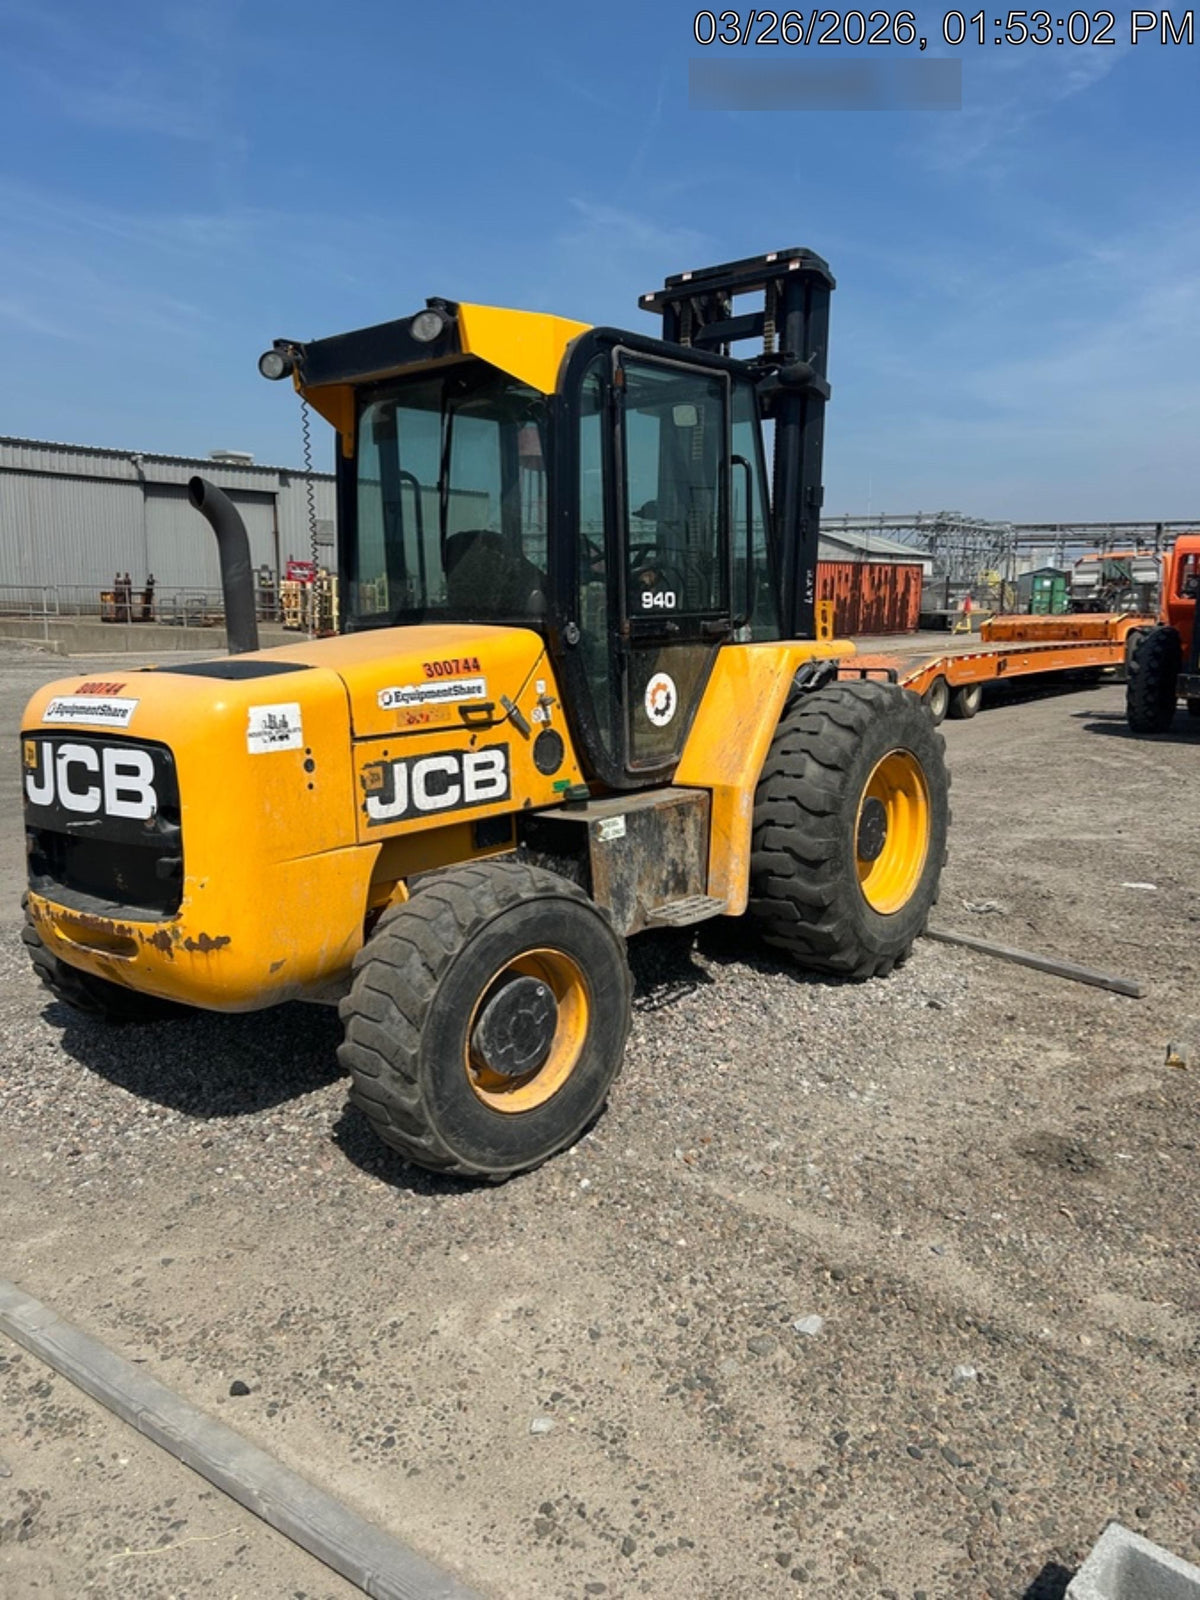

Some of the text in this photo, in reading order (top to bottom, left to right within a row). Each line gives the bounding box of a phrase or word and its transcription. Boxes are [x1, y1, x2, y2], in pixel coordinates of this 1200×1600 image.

[641, 591, 676, 609] 940
[422, 657, 481, 678] 300744
[394, 684, 483, 704] EquipmentShare
[55, 702, 129, 718] EquipmentShare
[26, 741, 158, 820] JCB
[366, 749, 509, 819] JCB
